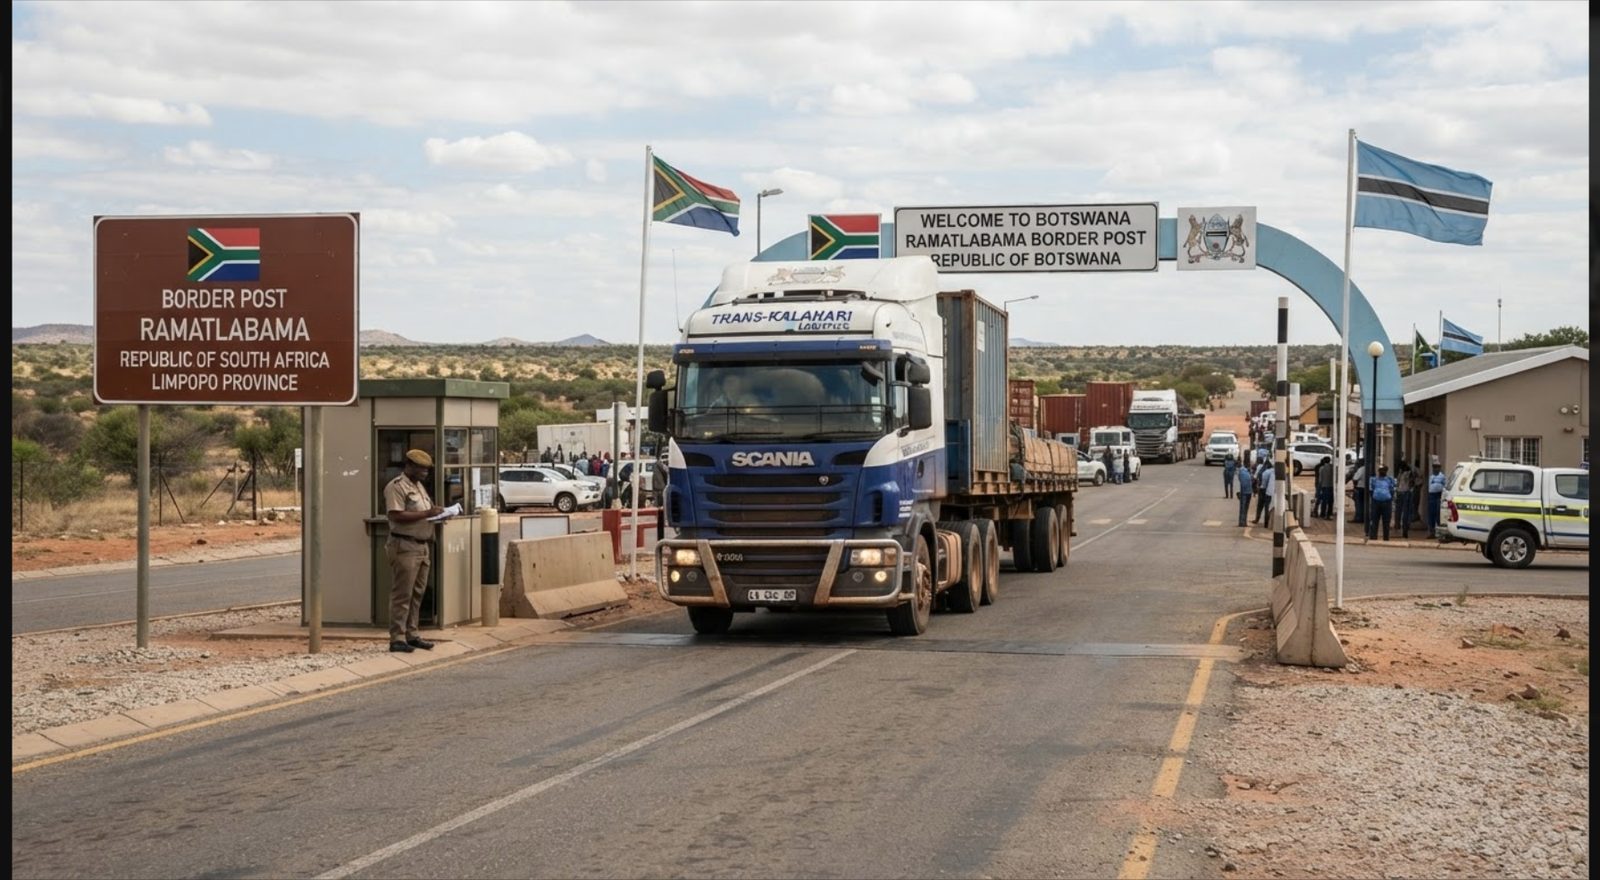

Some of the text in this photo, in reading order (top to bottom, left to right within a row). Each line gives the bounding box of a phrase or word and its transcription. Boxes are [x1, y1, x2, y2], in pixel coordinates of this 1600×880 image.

[920, 211, 1131, 228] WELCOME TO BOTSWANA
[905, 230, 1147, 248] RAMATLABAMA BORDER POST
[931, 251, 1122, 267] REPUBLIC OF BOTSWANA
[162, 288, 288, 309] BORDER POST
[140, 317, 310, 341] RAMATLABAMA
[120, 350, 330, 369] REPUBLIC OF SOUTH AFRICA
[151, 373, 298, 391] LIMPOPO PROVINCE
[731, 451, 815, 467] SCANIA
